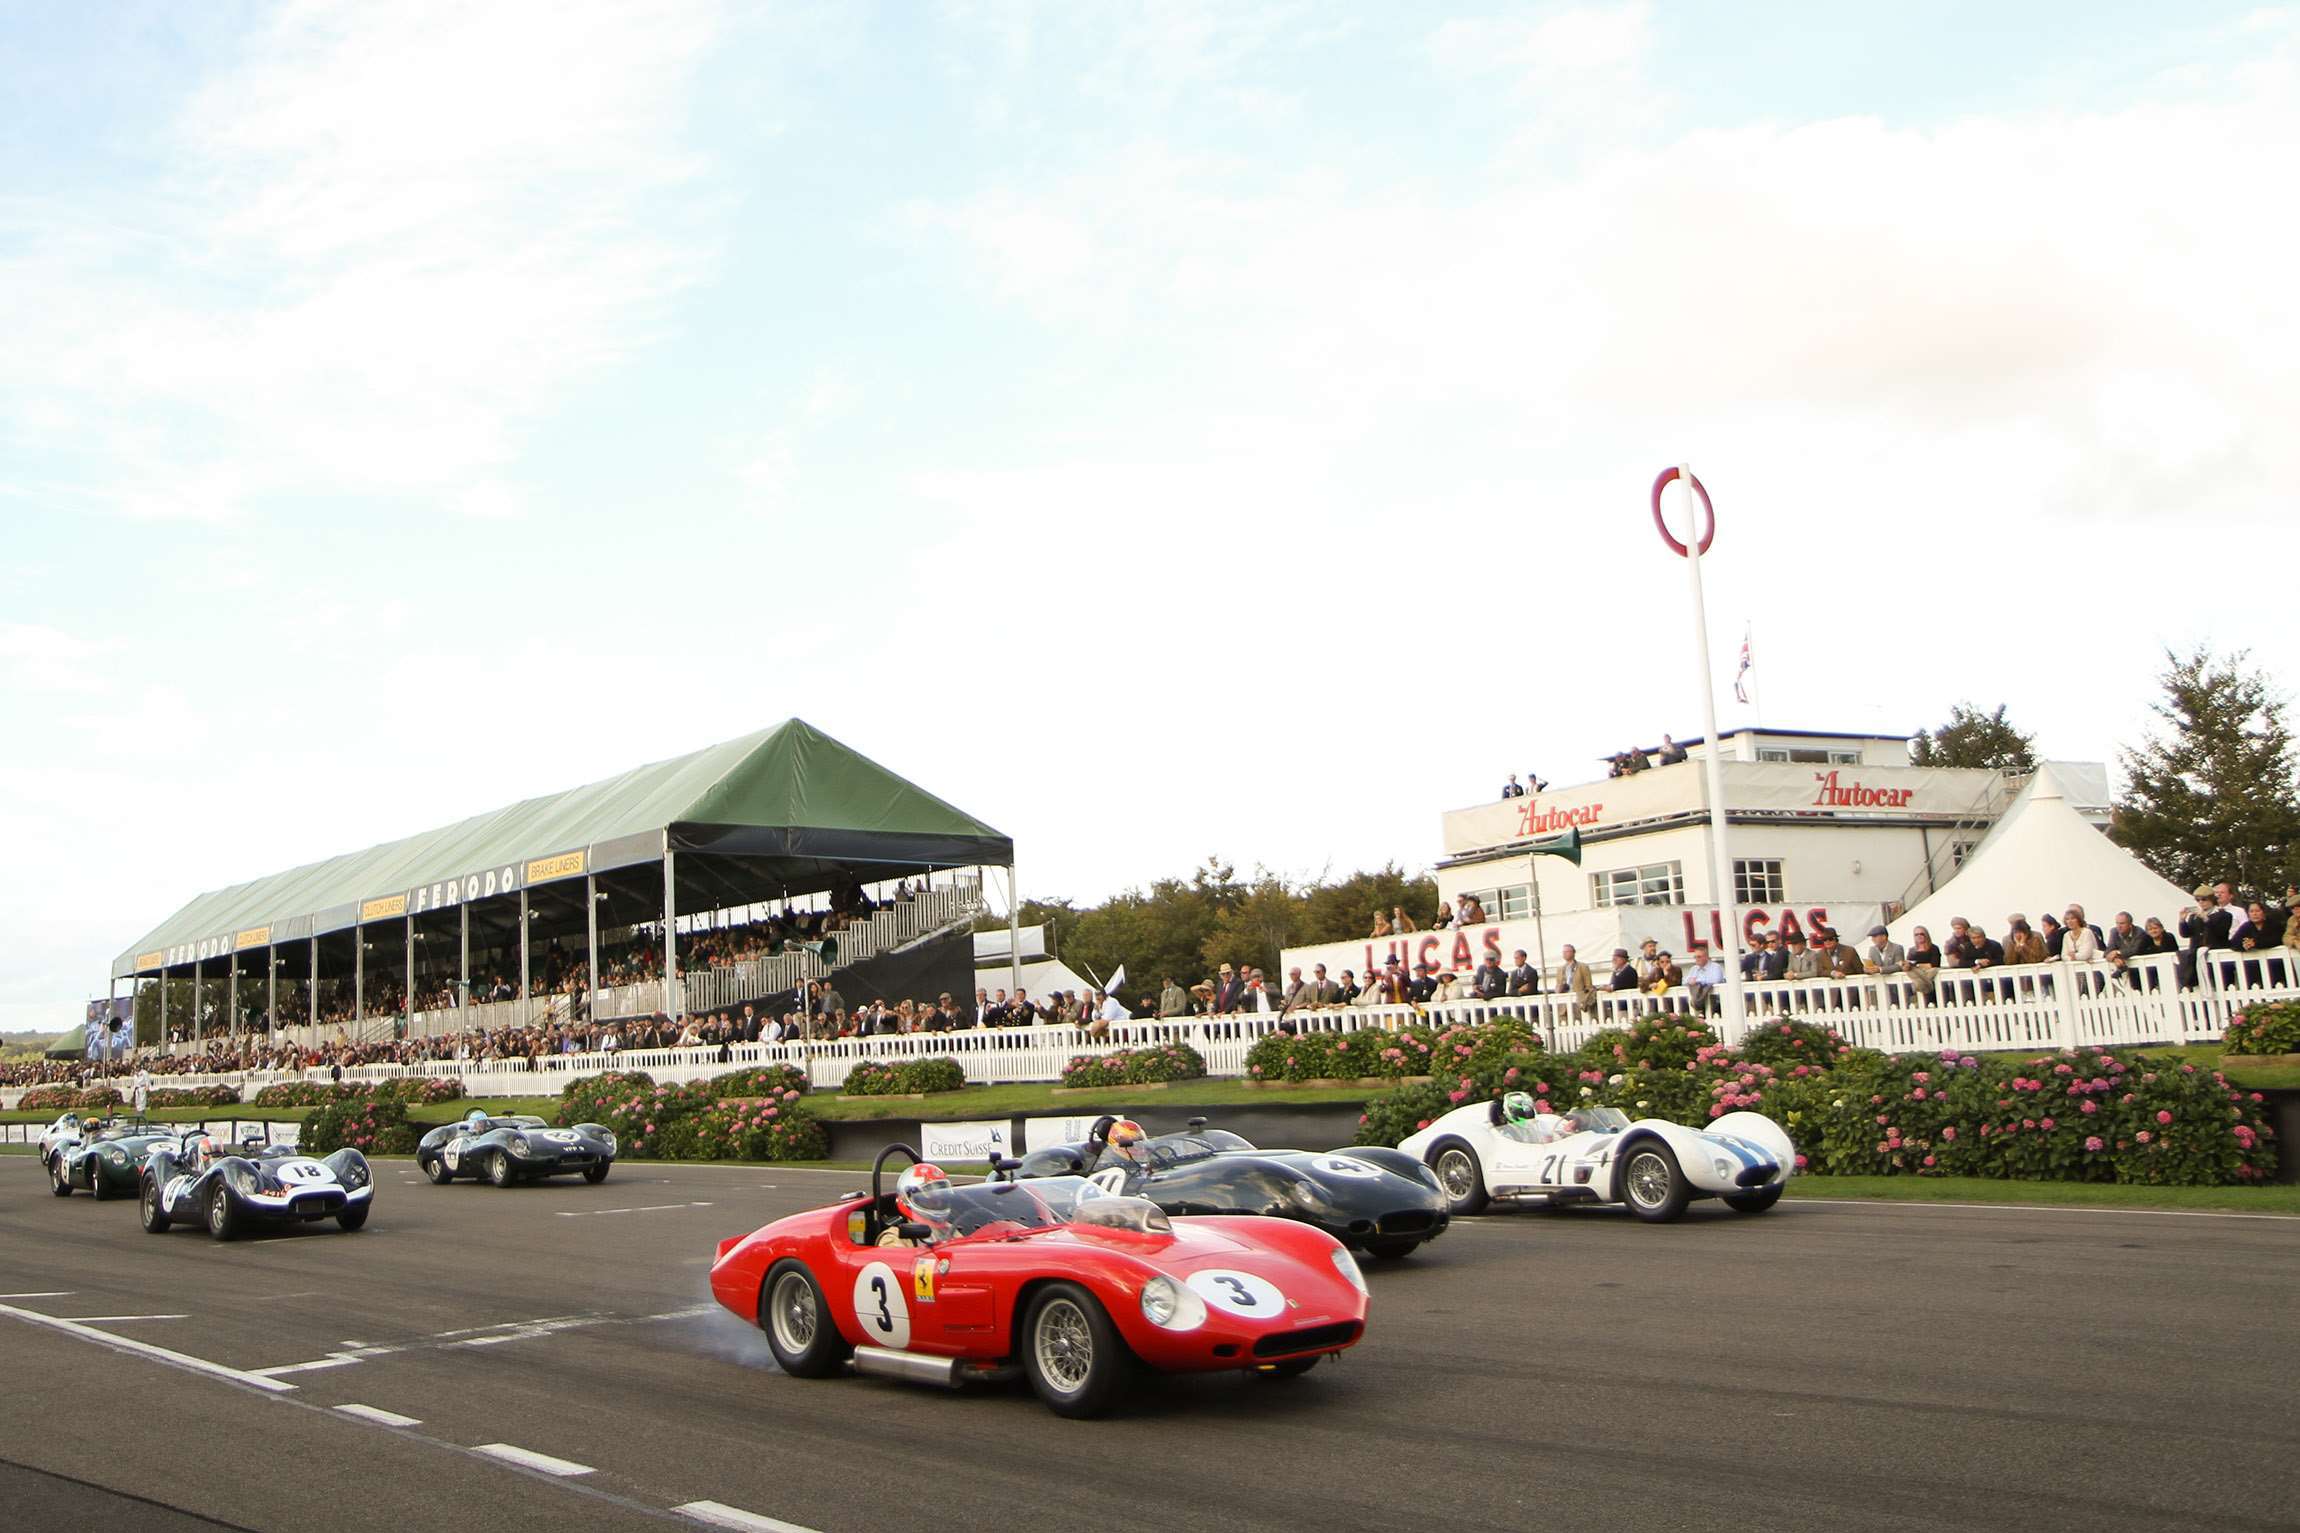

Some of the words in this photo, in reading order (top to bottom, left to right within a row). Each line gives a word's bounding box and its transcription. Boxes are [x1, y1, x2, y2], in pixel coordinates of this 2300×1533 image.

[1812, 770, 1913, 807] Autocar
[1515, 800, 1603, 836] Autocar
[531, 859, 554, 878] BRAKE
[555, 855, 580, 874] LINERS
[417, 866, 514, 913] FERODO
[168, 935, 229, 967] FERODO
[929, 1140, 963, 1157] CREDIT
[292, 1165, 322, 1178] 18
[1540, 1154, 1567, 1185] 21
[871, 1276, 893, 1332] 3
[1213, 1276, 1257, 1306] 3
